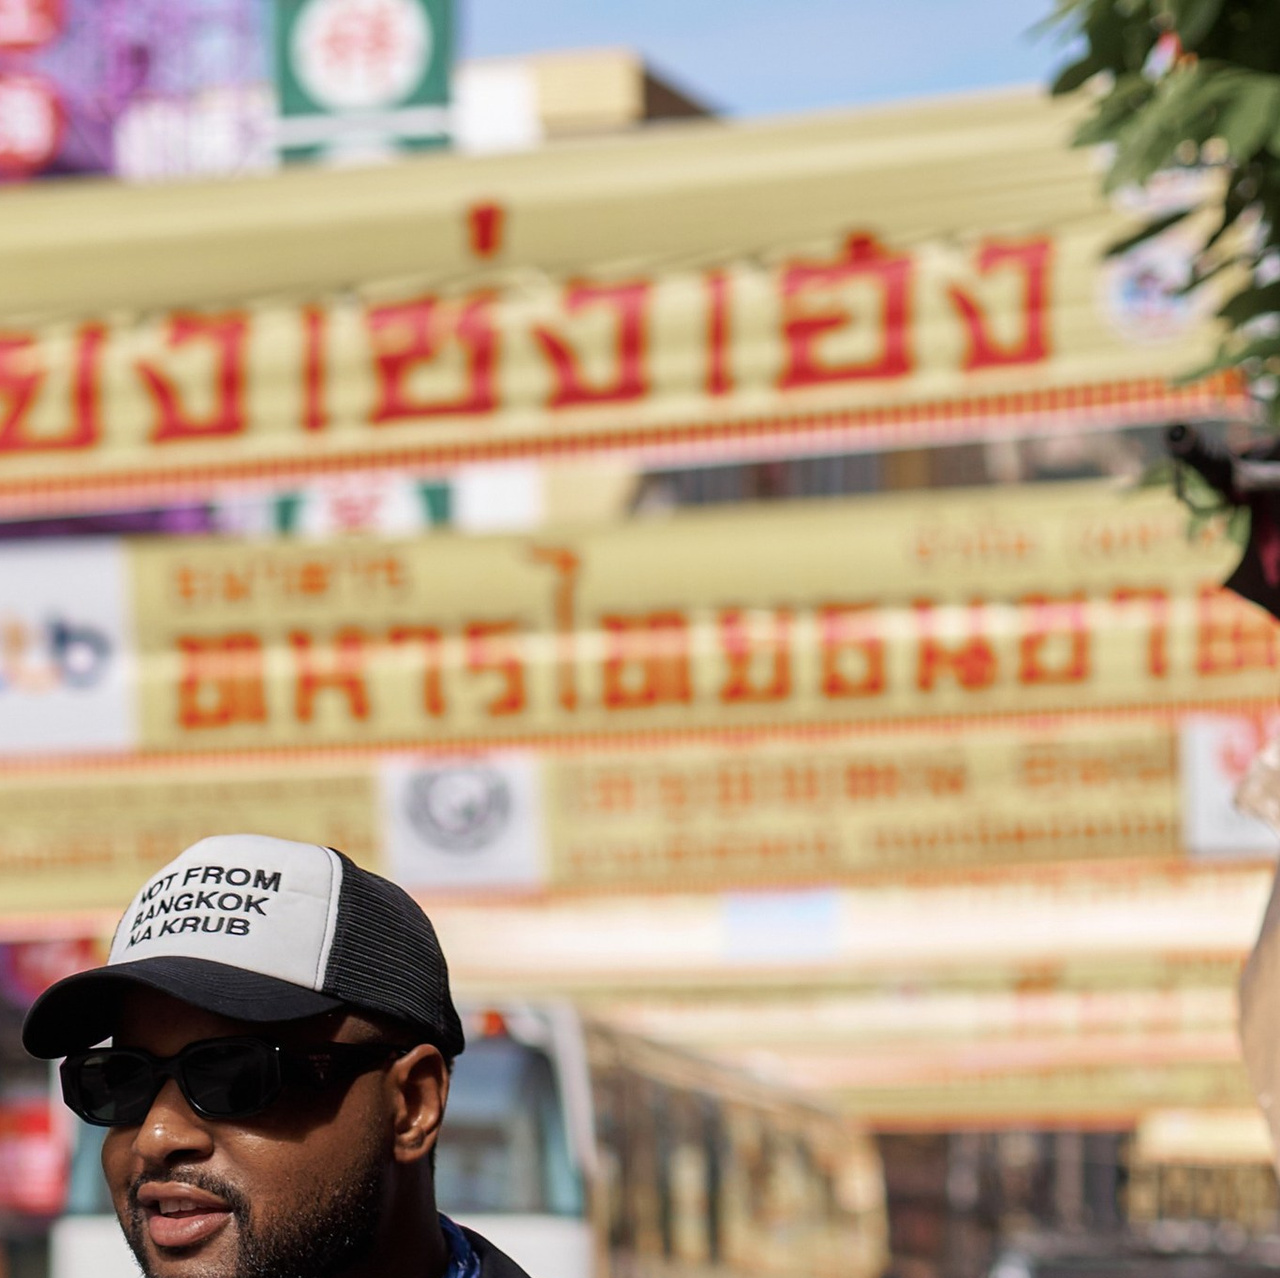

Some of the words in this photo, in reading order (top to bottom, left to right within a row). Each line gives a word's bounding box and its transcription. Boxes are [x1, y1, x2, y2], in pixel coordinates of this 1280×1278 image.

[140, 872, 178, 904] NOT
[182, 865, 282, 892] FROM
[130, 891, 269, 932] BANGKOK
[126, 925, 152, 949] NA
[158, 916, 250, 936] KRUB
